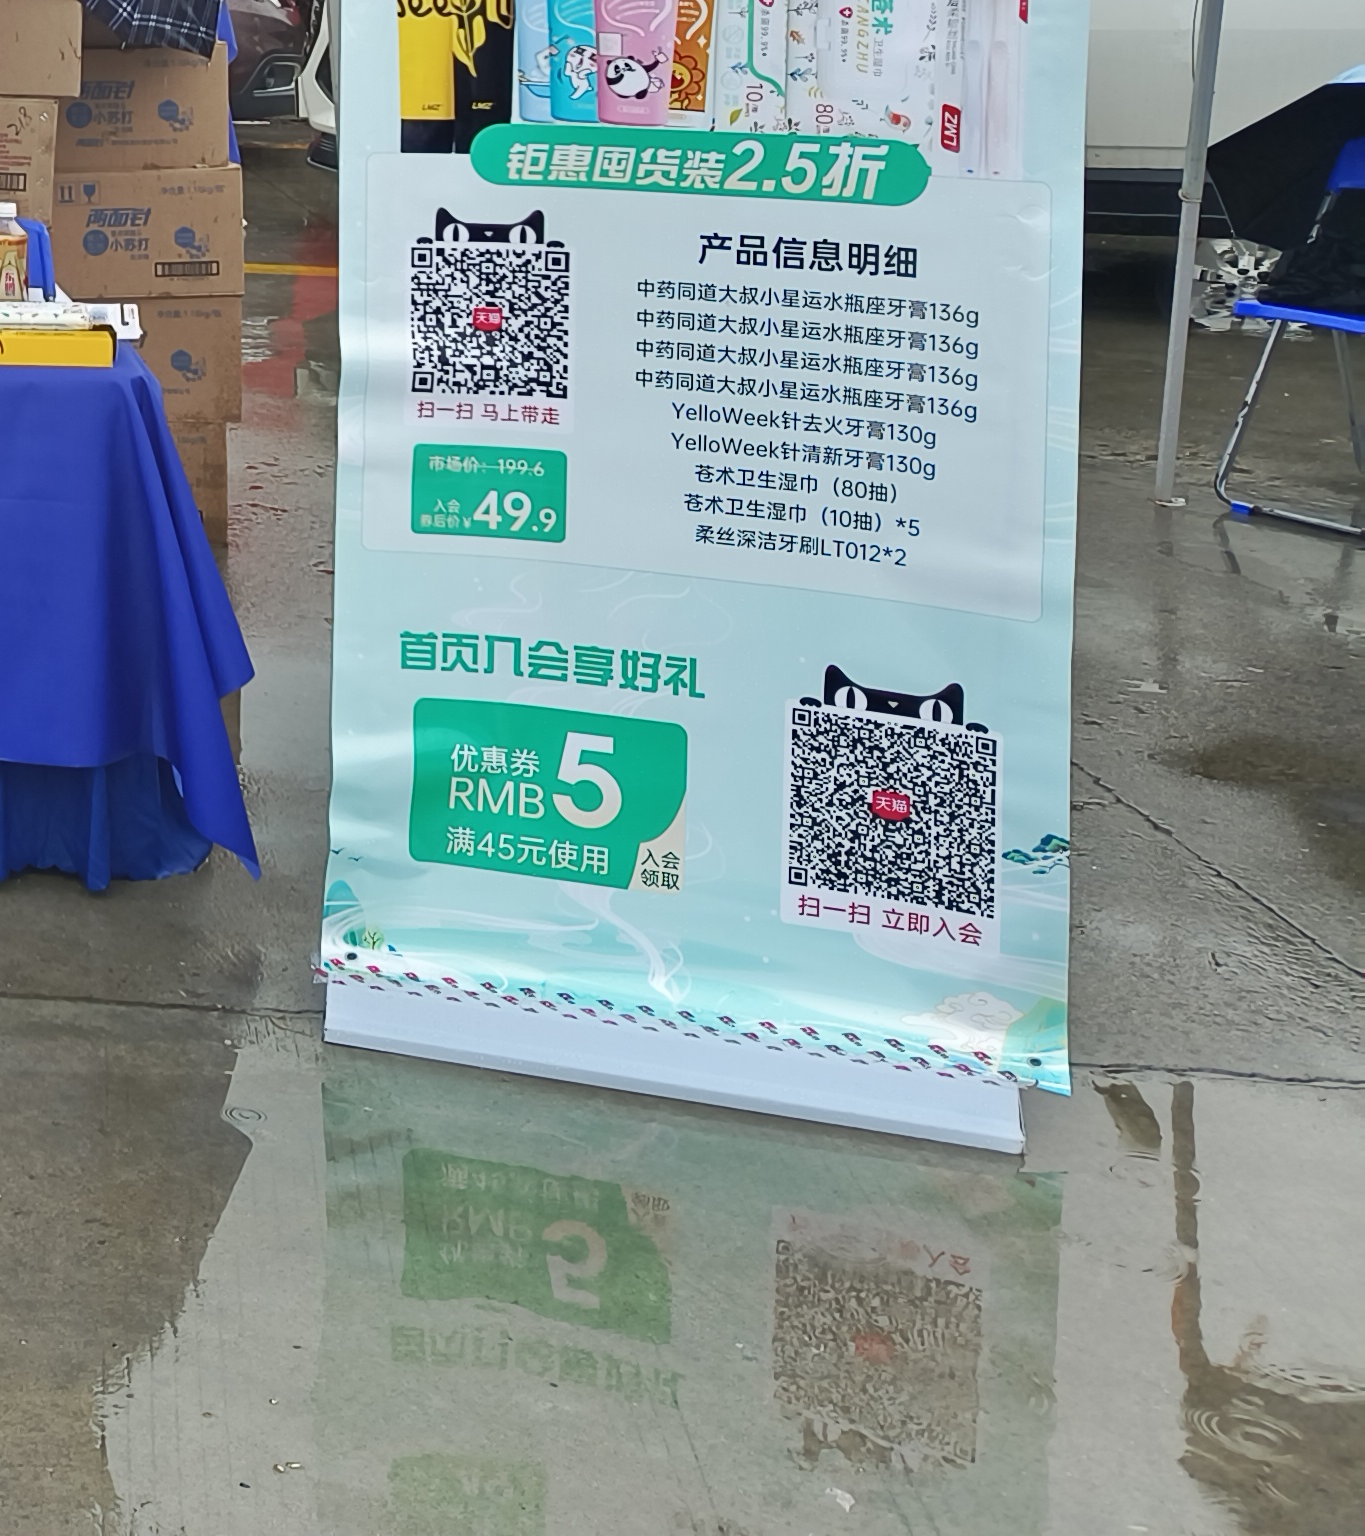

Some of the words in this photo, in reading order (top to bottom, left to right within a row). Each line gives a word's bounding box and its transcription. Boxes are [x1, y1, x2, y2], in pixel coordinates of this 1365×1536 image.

[944, 111, 958, 147] LMZ
[506, 136, 888, 202] 钜惠囤货装2.5折
[86, 208, 151, 228] 两面针
[110, 237, 149, 252] 小苏打
[698, 232, 919, 279] 产品信息明细
[637, 279, 980, 328] 中药同道大叔小星运水瓶座牙膏136g
[636, 309, 980, 360] 中药同道大叔小星运水瓶座牙膏136g
[635, 339, 979, 391] 中药同道大叔小星运水瓶座牙膏136g
[417, 401, 474, 420] 扫一扫
[481, 403, 561, 426] 马上带走
[635, 369, 978, 423] 中药同道大叔小星运水瓶座牙膏136g
[671, 401, 937, 449] YelloWeek针去火牙膏130g
[671, 432, 937, 481] YelloWeek针清新牙膏130g
[472, 488, 557, 533] 49.9
[399, 630, 706, 700] 首页入会享好礼
[450, 743, 541, 778] 优惠券
[552, 731, 624, 829] 5
[448, 778, 547, 823] RMB
[873, 795, 910, 815] 天猫
[445, 827, 611, 877] 满45元使用
[640, 847, 682, 871] 入会
[640, 869, 682, 892] 领取
[797, 894, 872, 927] 扫一扫
[881, 905, 984, 947] 立即入会
